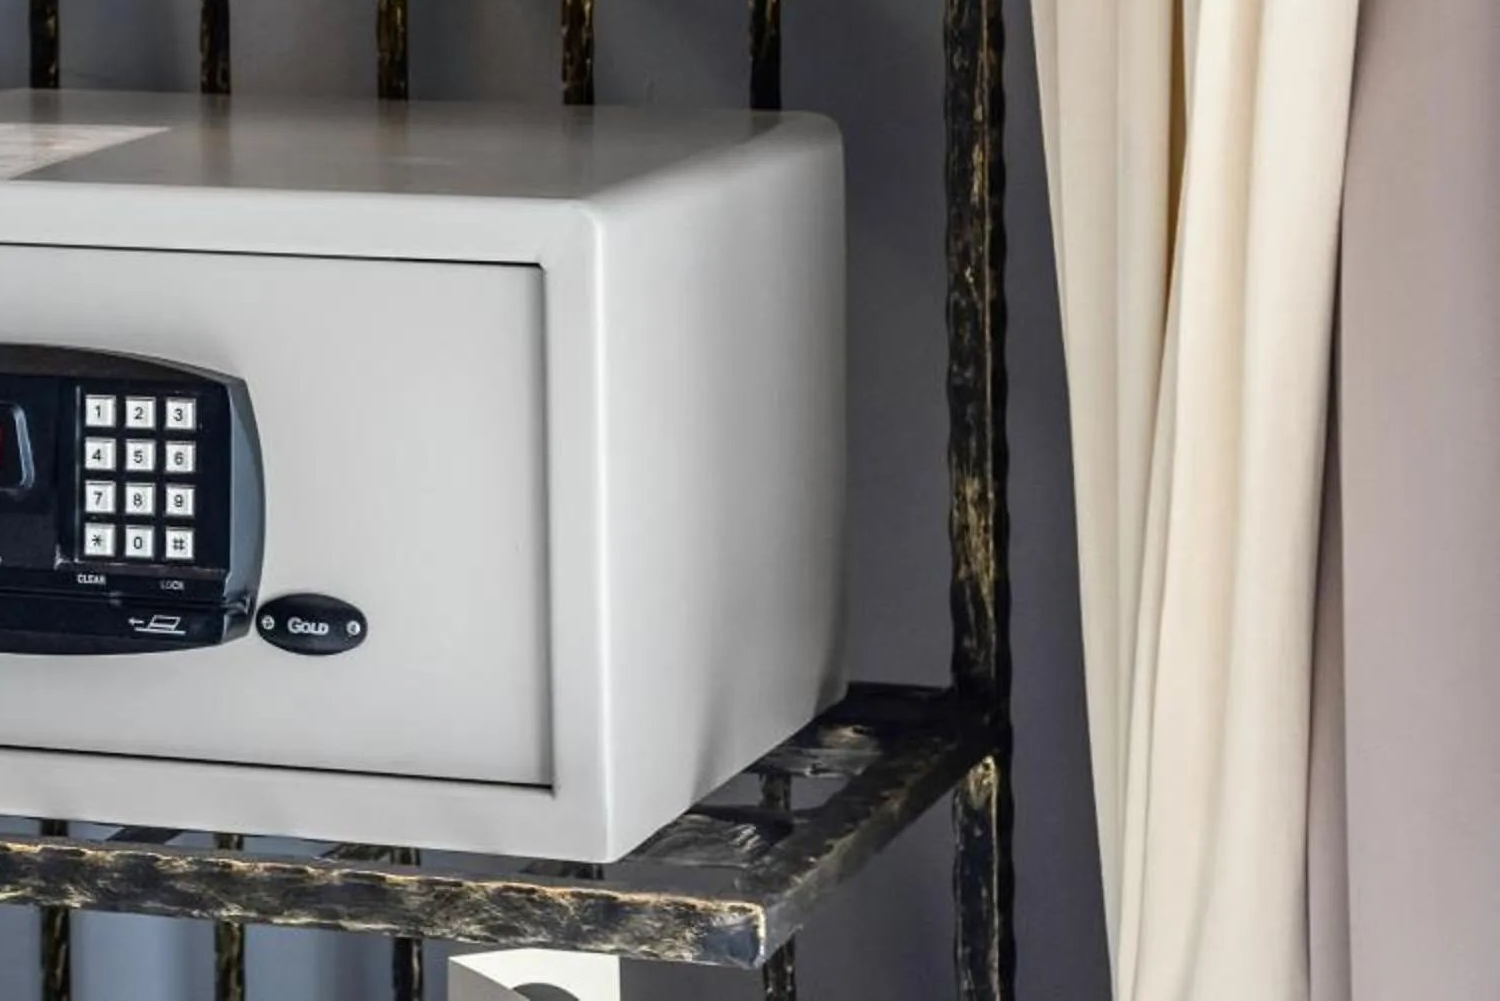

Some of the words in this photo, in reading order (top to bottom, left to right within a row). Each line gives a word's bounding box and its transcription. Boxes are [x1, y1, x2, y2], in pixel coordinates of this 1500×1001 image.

[134, 407, 144, 420] 2
[173, 408, 184, 422] 3
[92, 449, 102, 462] 4
[133, 450, 143, 464] 5
[174, 451, 184, 466] 6
[93, 491, 103, 505] 7
[133, 493, 143, 507] 8
[173, 494, 183, 508] 9
[133, 536, 143, 550] 0
[77, 574, 107, 585] CLEAR
[287, 616, 329, 636] GOLD
